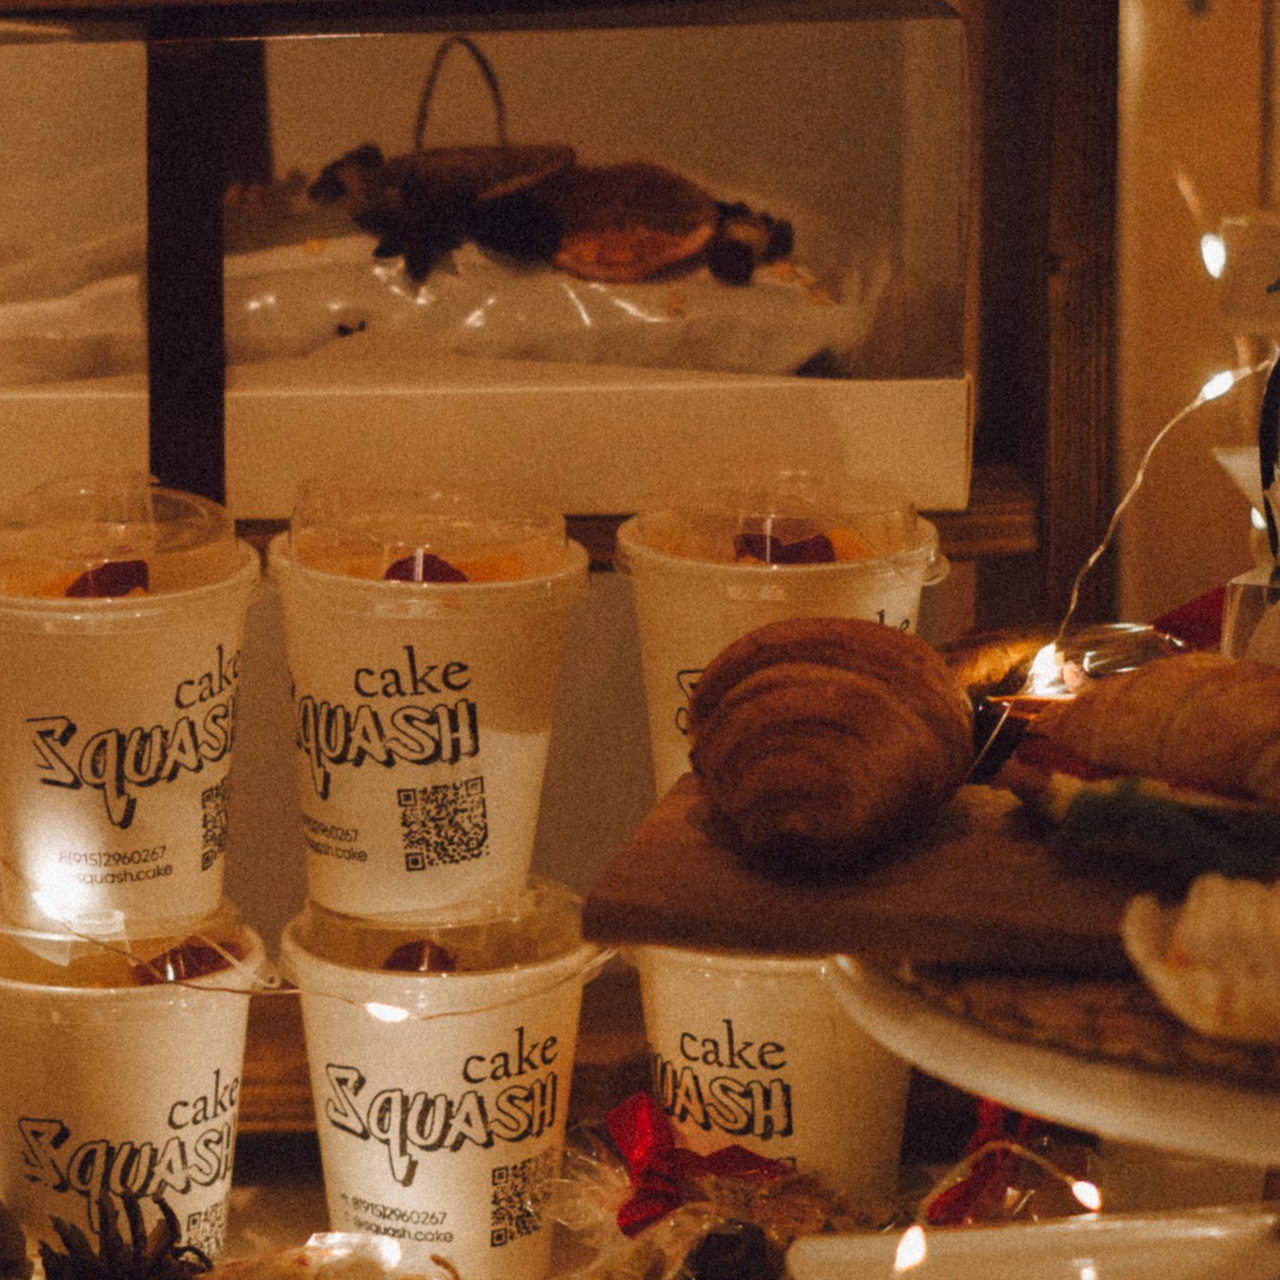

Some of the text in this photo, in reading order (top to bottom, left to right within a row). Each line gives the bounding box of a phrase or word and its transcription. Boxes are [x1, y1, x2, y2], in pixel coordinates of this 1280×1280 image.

[354, 645, 471, 699] cake
[462, 1026, 559, 1085] cake
[679, 1018, 788, 1071] cake
[167, 1067, 240, 1131] cake
